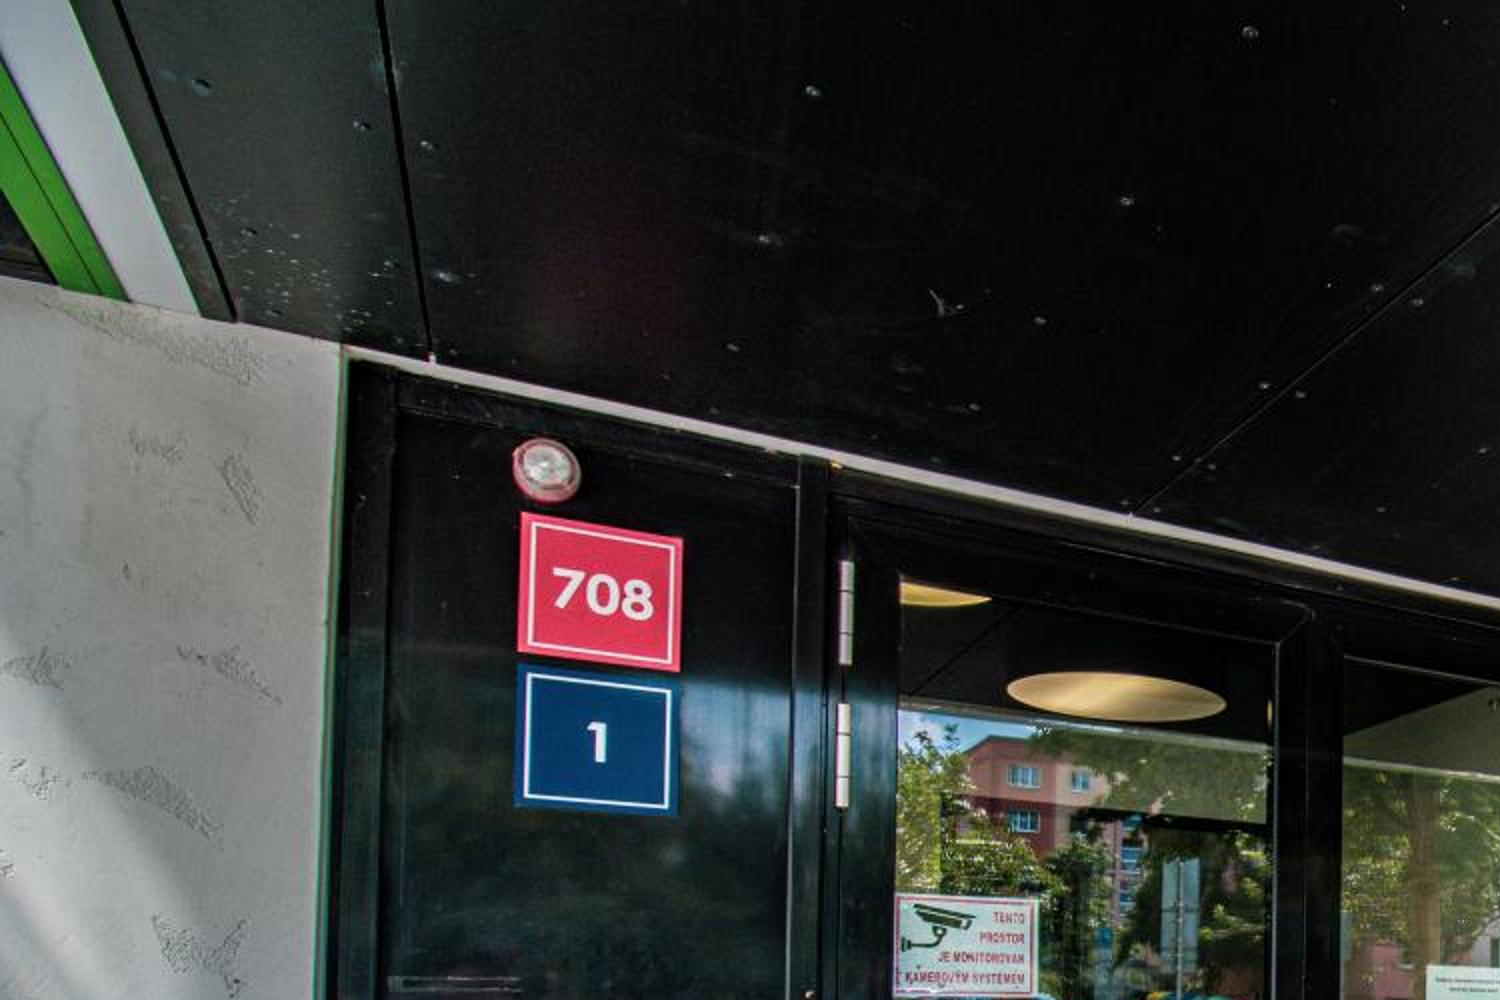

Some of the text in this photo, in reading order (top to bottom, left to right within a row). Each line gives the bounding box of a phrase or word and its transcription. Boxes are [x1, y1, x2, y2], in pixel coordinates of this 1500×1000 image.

[553, 567, 654, 621] 708
[586, 721, 607, 763] 1
[993, 912, 1024, 924] TENTO
[980, 932, 1024, 944] PROSTOR
[938, 952, 950, 963] JE
